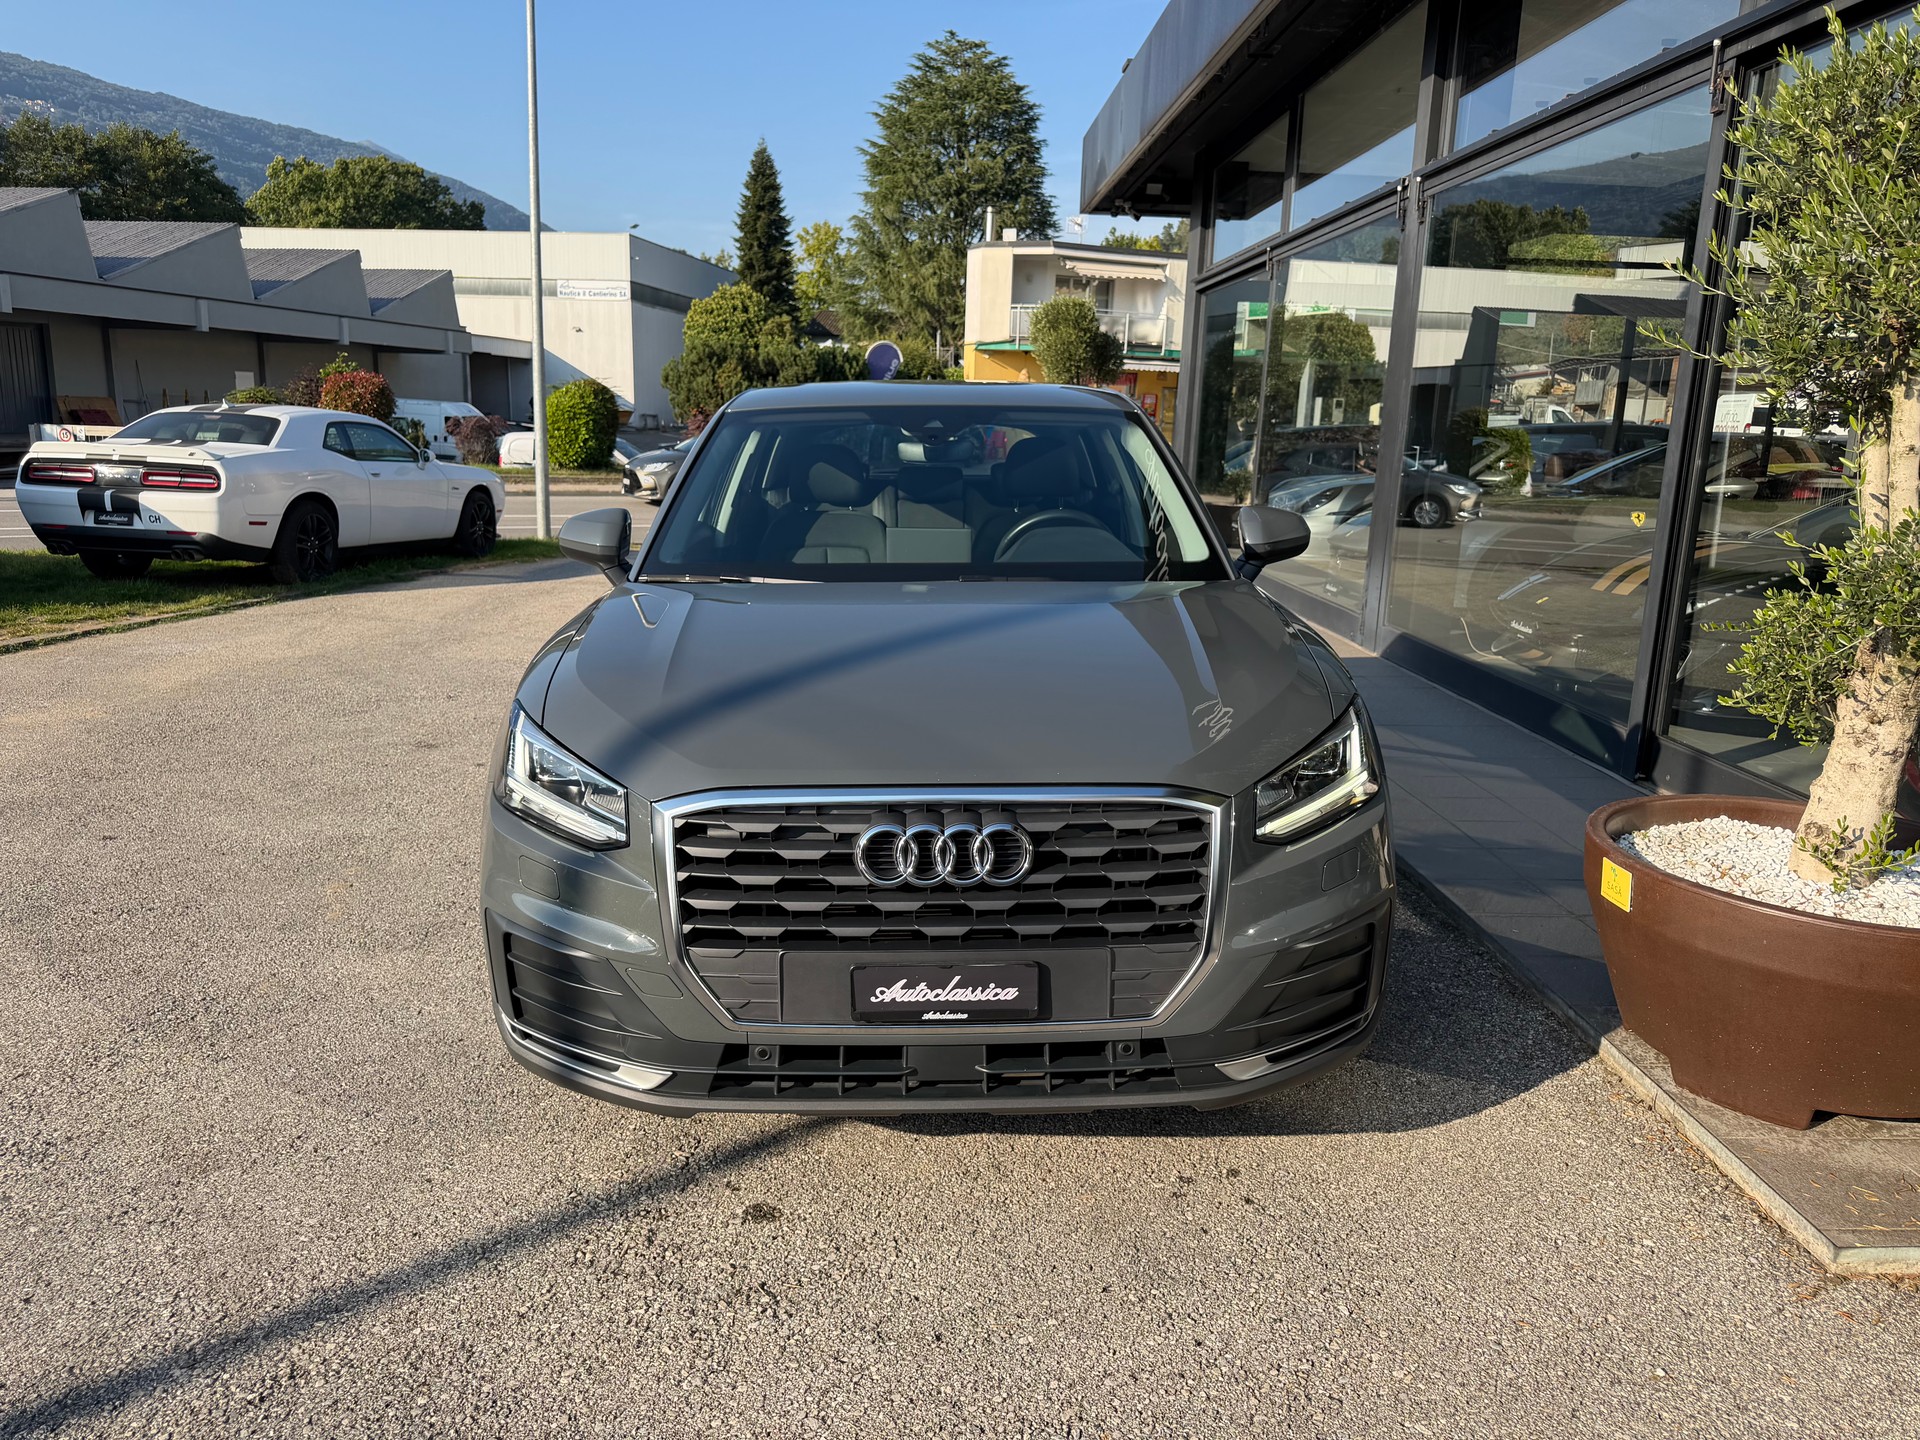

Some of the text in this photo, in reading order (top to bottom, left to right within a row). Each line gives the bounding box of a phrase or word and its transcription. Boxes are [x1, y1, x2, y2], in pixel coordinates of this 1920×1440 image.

[61, 431, 69, 439] 15
[148, 514, 162, 525] CH
[870, 975, 1019, 1003] Autoclassica
[921, 1010, 969, 1020] Autoclassica
